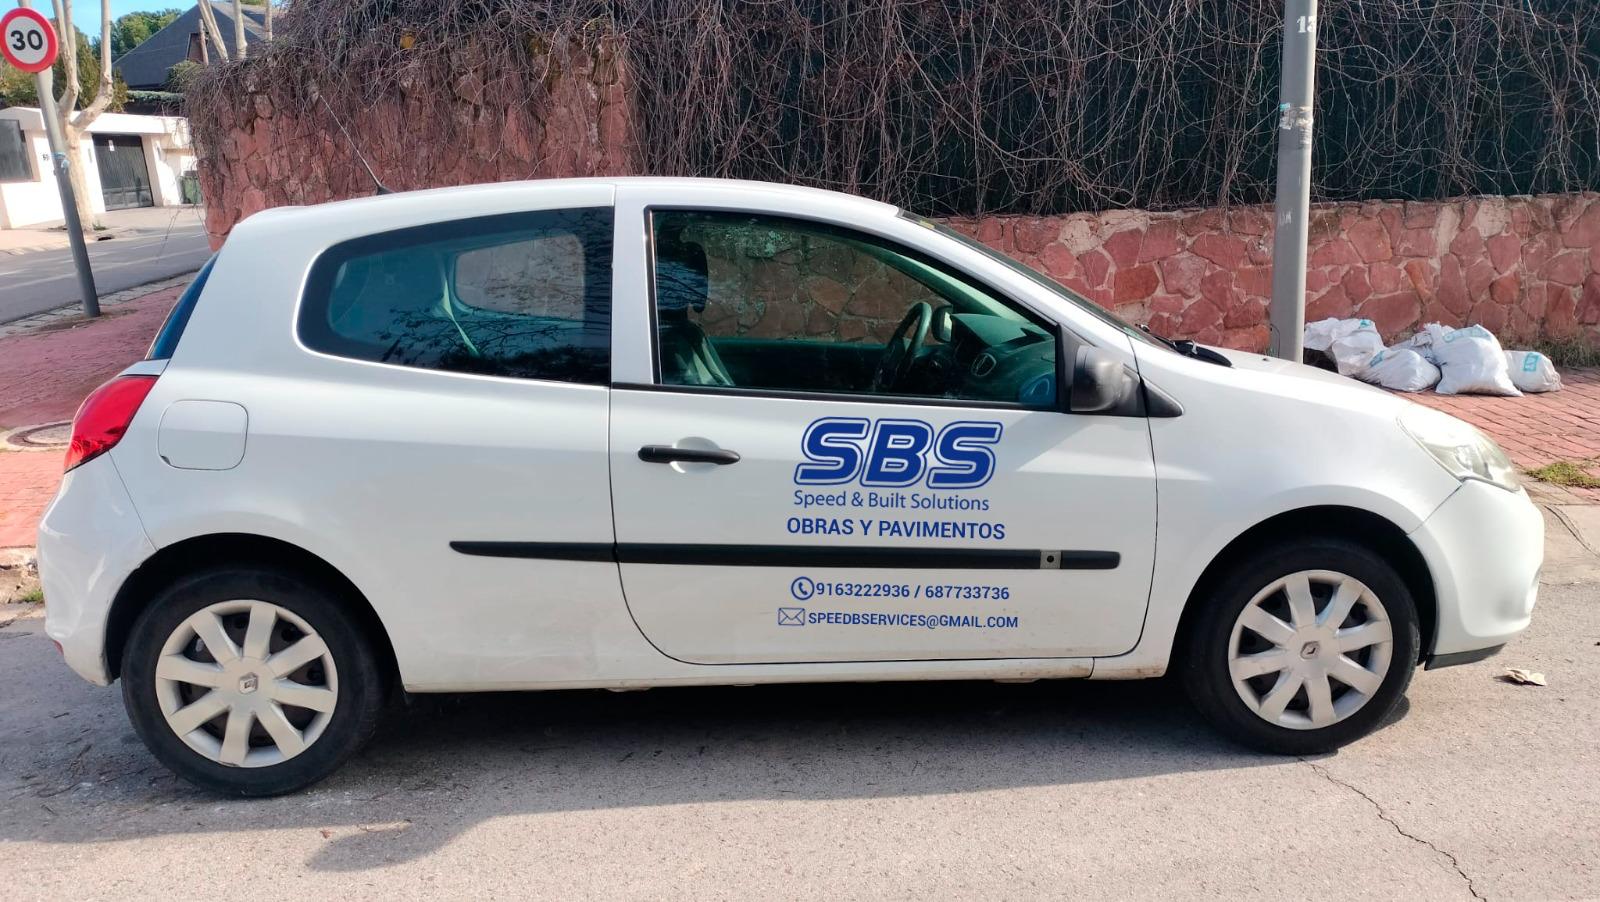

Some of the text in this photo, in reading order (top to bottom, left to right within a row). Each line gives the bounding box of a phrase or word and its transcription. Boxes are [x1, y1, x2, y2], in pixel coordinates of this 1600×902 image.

[10, 29, 43, 51] 30
[794, 416, 1003, 489] SBS
[794, 490, 989, 511] Speed & Built Solutions
[787, 517, 1005, 540] OBRAS Y PAVIMENTOS
[816, 582, 1010, 600] 9163222936 / 687733736
[808, 612, 1018, 629] SPEEDBSERVICES@GMAIL.COM
